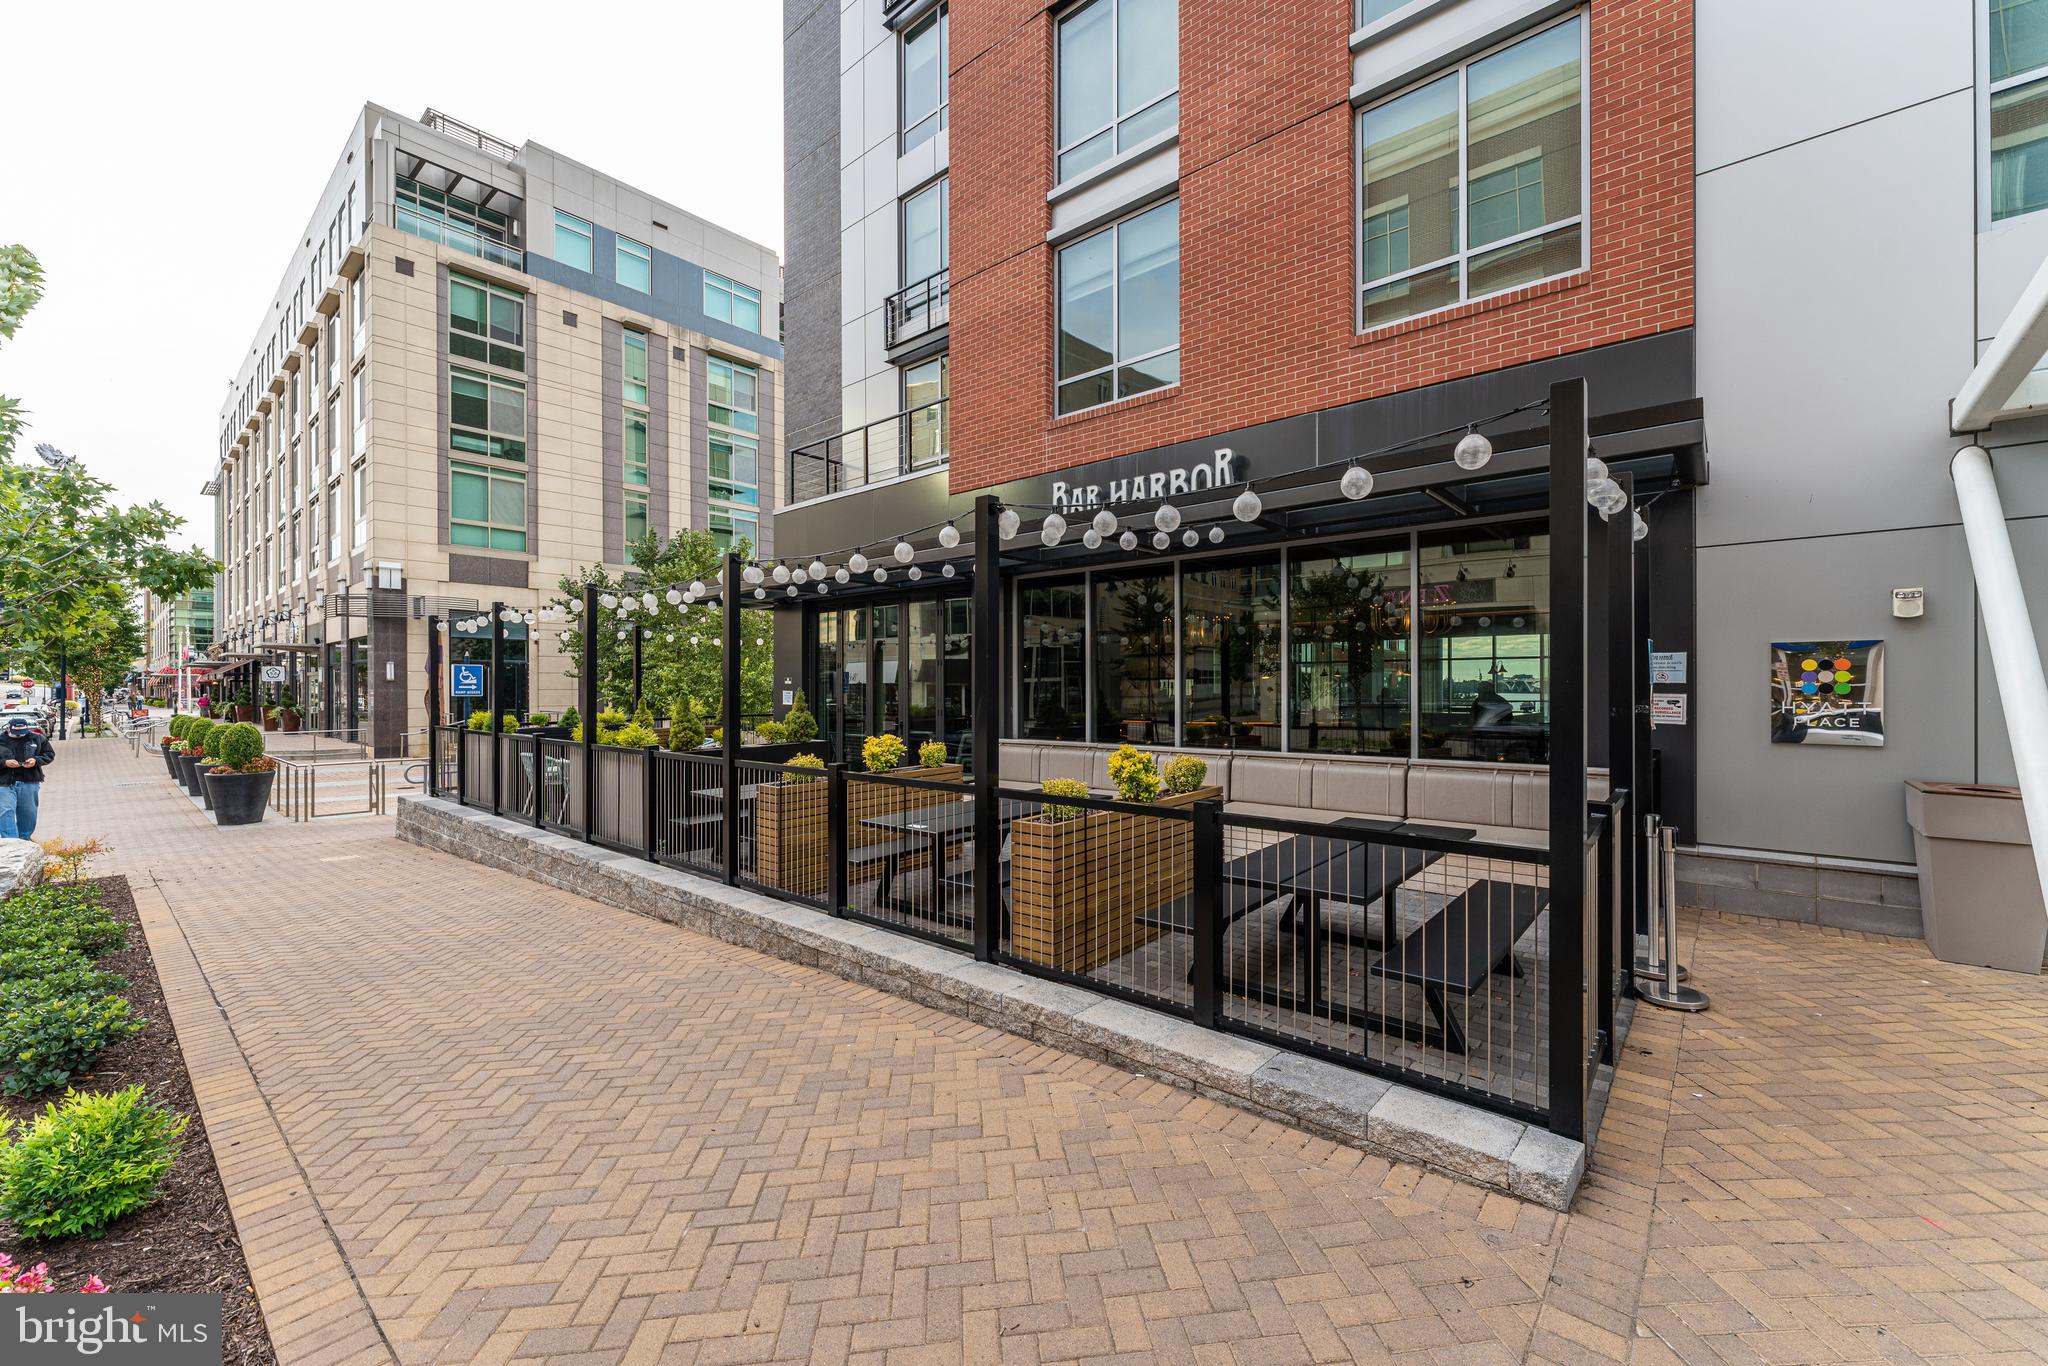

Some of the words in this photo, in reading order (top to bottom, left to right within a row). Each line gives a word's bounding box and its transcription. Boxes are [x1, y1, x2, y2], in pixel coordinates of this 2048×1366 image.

[1052, 481, 1101, 515] BAR
[1109, 447, 1233, 506] HARBOR
[1781, 701, 1872, 715] HYATT
[1794, 717, 1860, 728] PLACE
